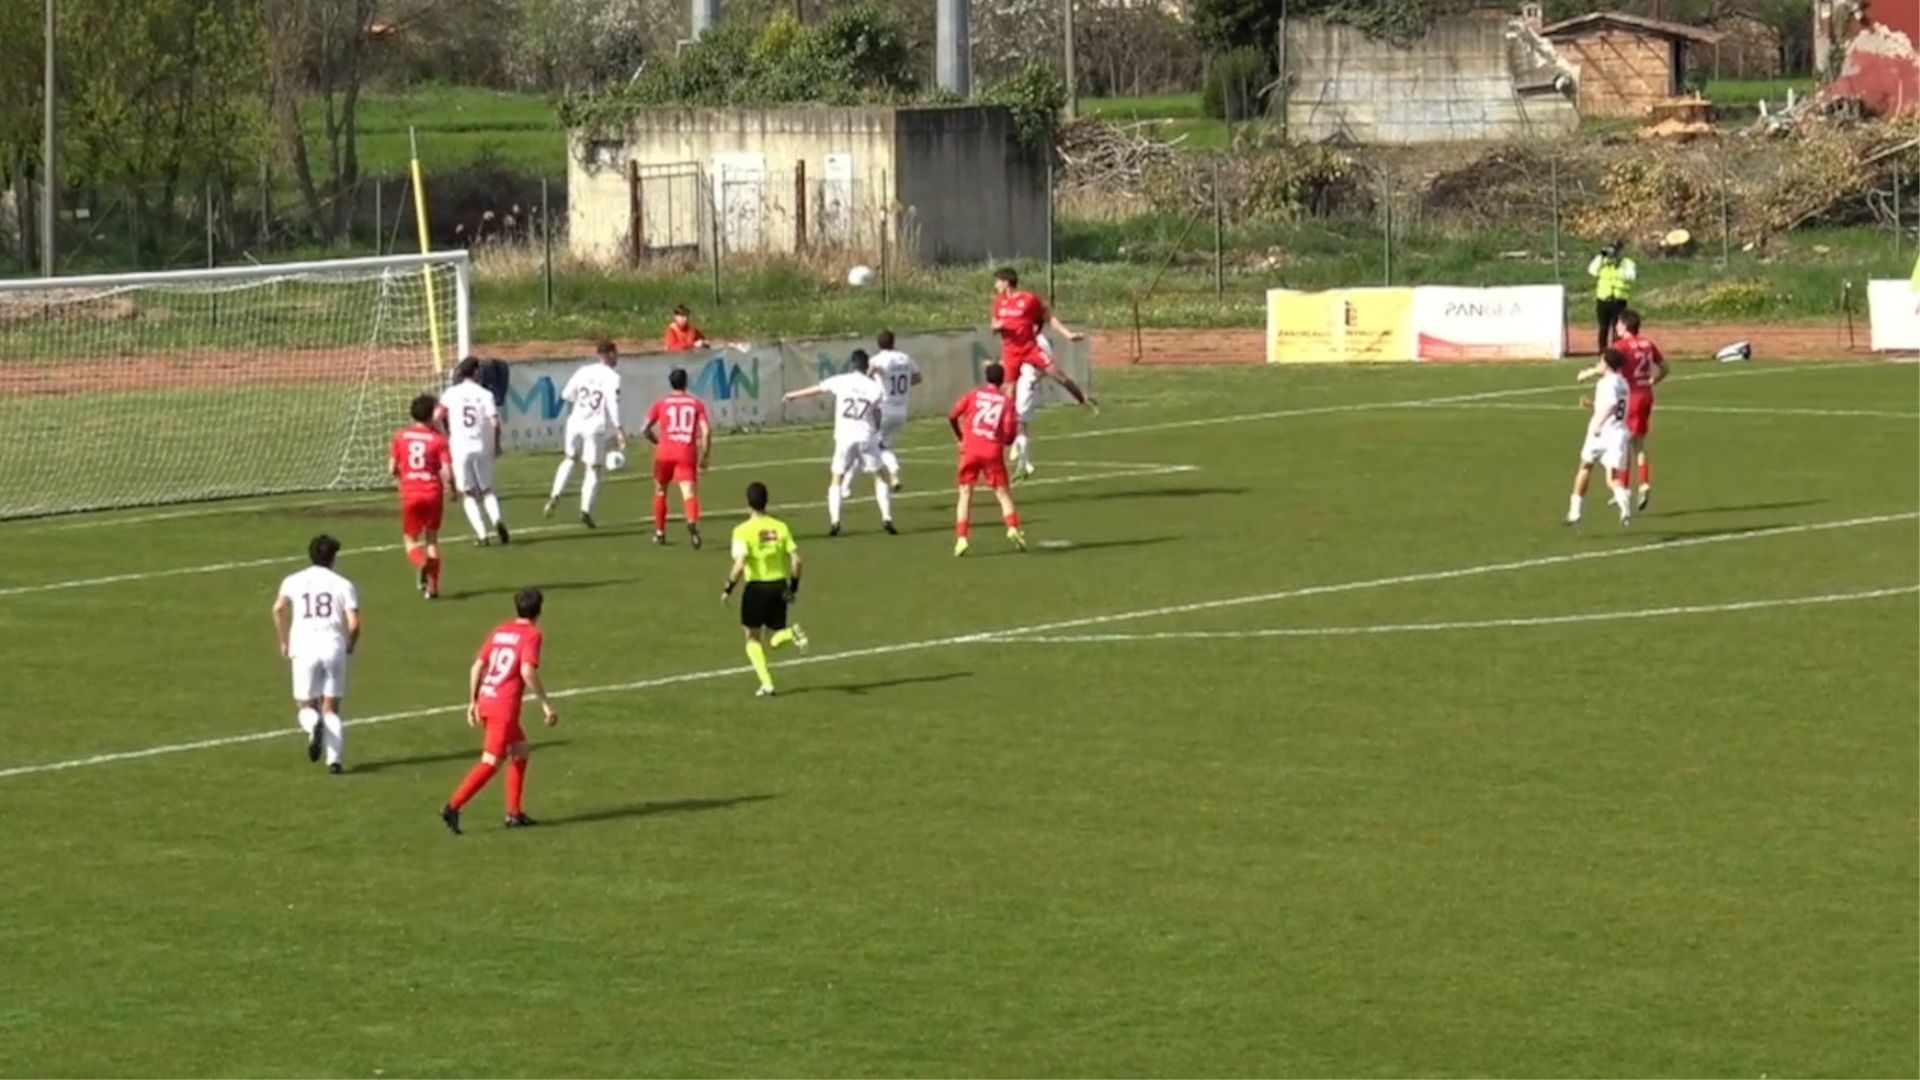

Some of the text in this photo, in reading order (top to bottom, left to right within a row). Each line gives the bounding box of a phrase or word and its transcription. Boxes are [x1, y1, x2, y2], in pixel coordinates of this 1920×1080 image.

[889, 374, 908, 396] 10
[579, 387, 603, 411] 23
[842, 398, 871, 420] 27
[462, 405, 476, 428] 5
[666, 405, 696, 433] 10
[972, 399, 1004, 430] 74
[408, 440, 426, 470] 8
[302, 592, 333, 619] 18
[483, 646, 516, 685] 19
